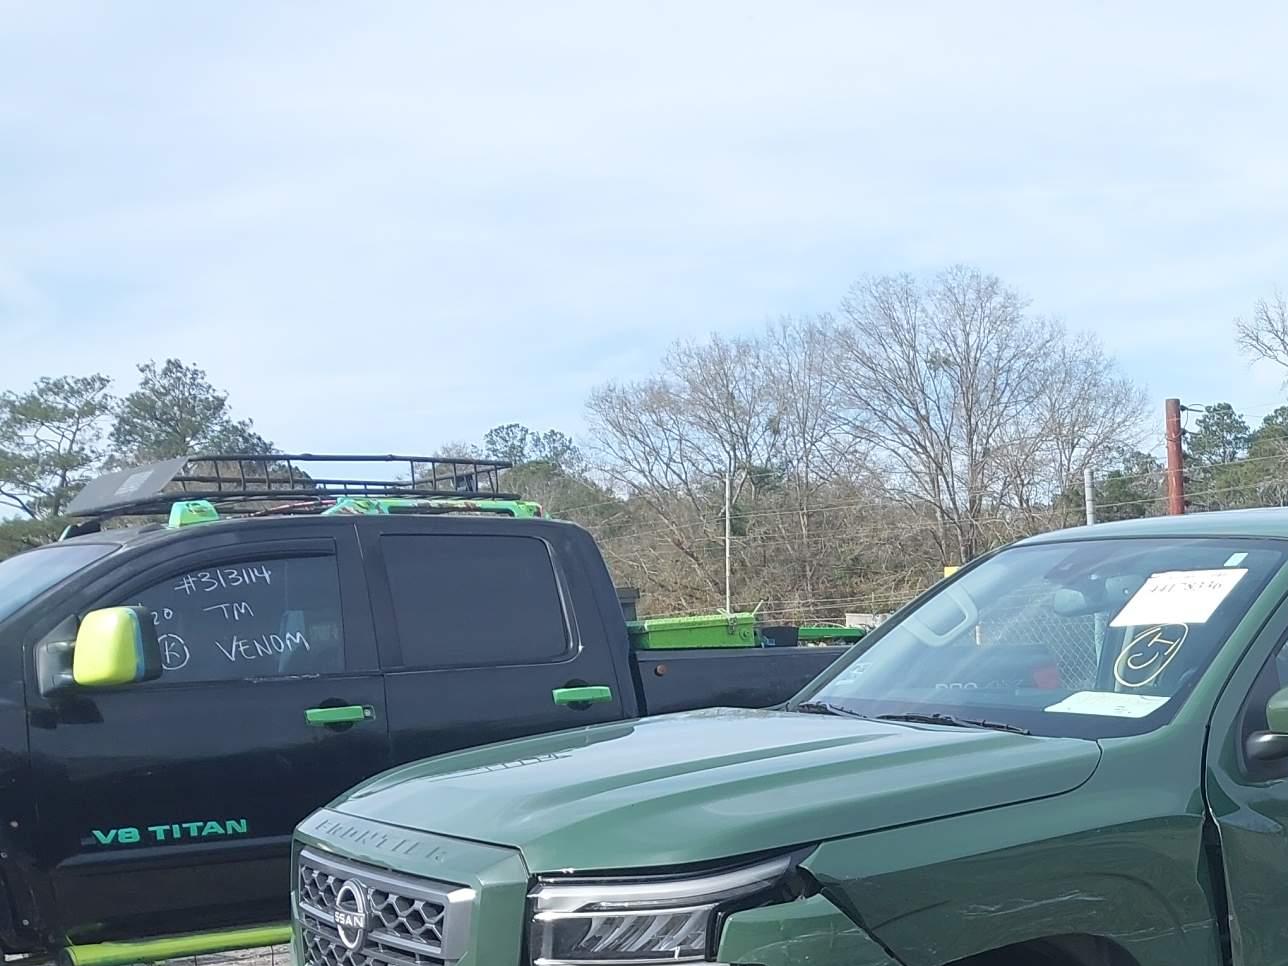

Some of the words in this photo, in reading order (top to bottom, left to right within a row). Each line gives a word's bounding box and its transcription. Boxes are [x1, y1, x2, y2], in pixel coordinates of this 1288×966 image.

[174, 565, 272, 595] #313114
[203, 601, 255, 620] TM
[216, 631, 311, 661] VENOM
[92, 827, 140, 844] V8
[148, 819, 248, 840] TITAN
